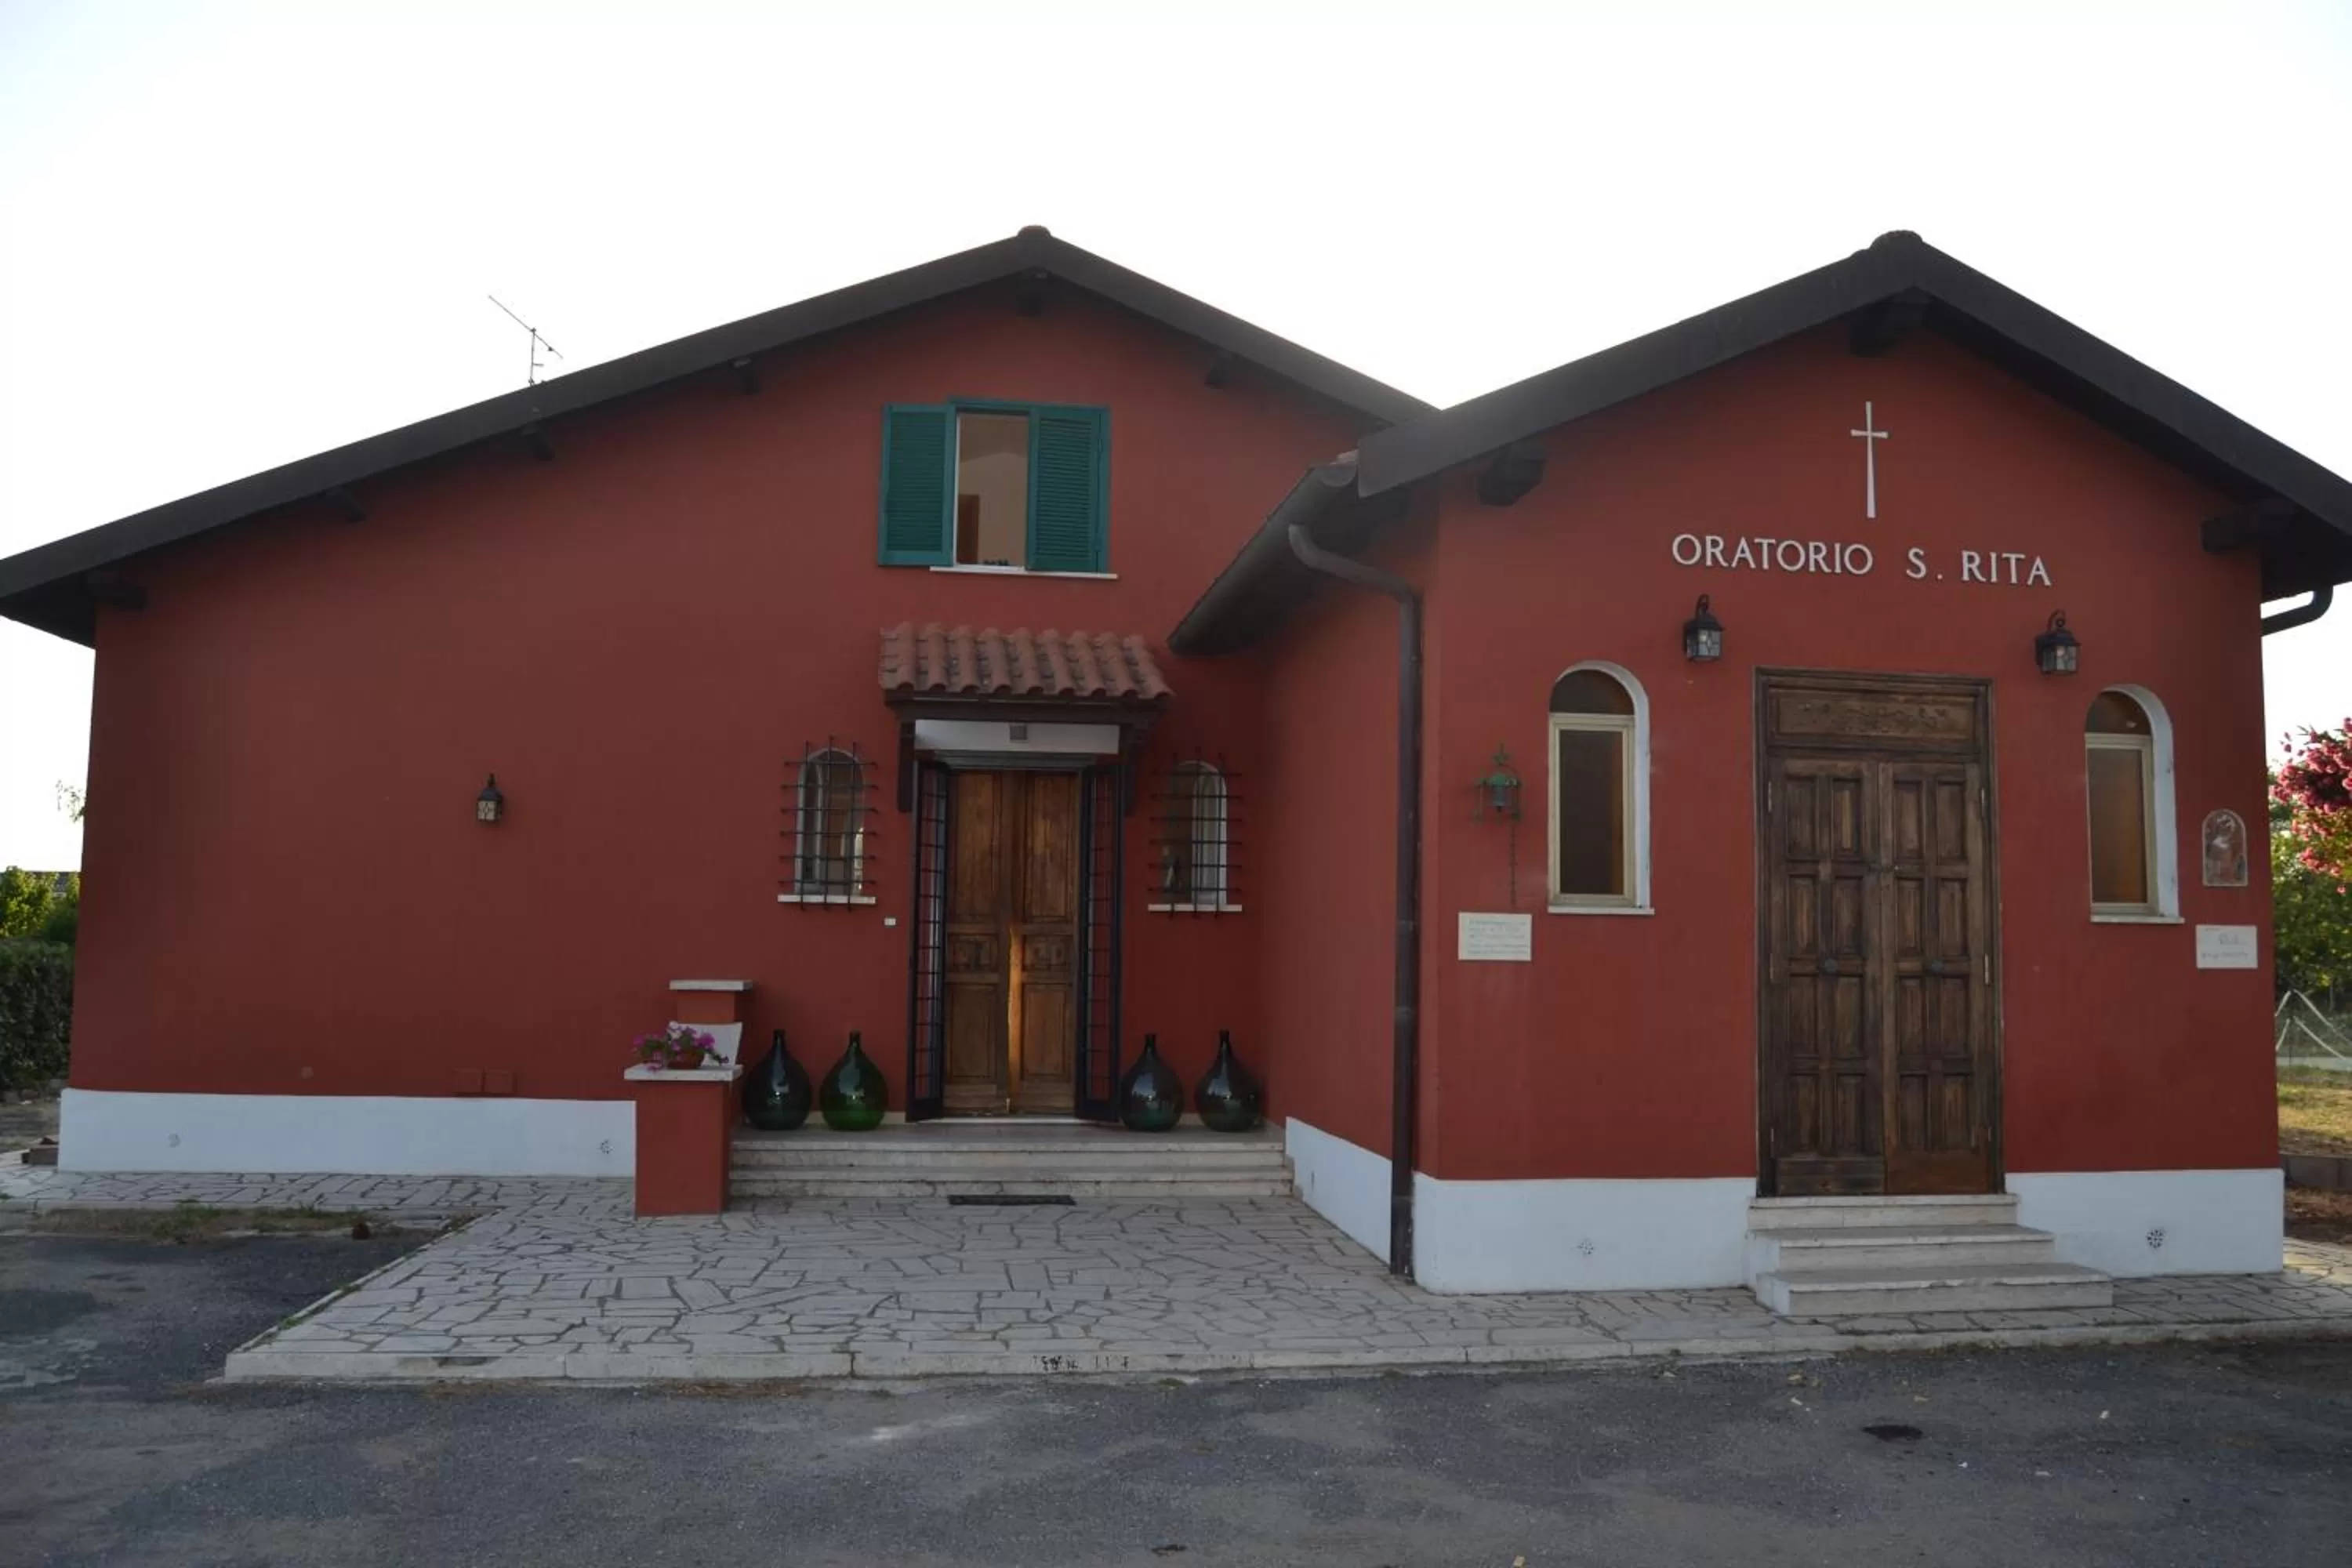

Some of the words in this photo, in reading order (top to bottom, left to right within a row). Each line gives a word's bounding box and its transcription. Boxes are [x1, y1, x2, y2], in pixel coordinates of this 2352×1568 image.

[1671, 533, 1873, 575] ORATORIO
[1906, 547, 1944, 580] S.
[1962, 550, 2052, 586] RITA
